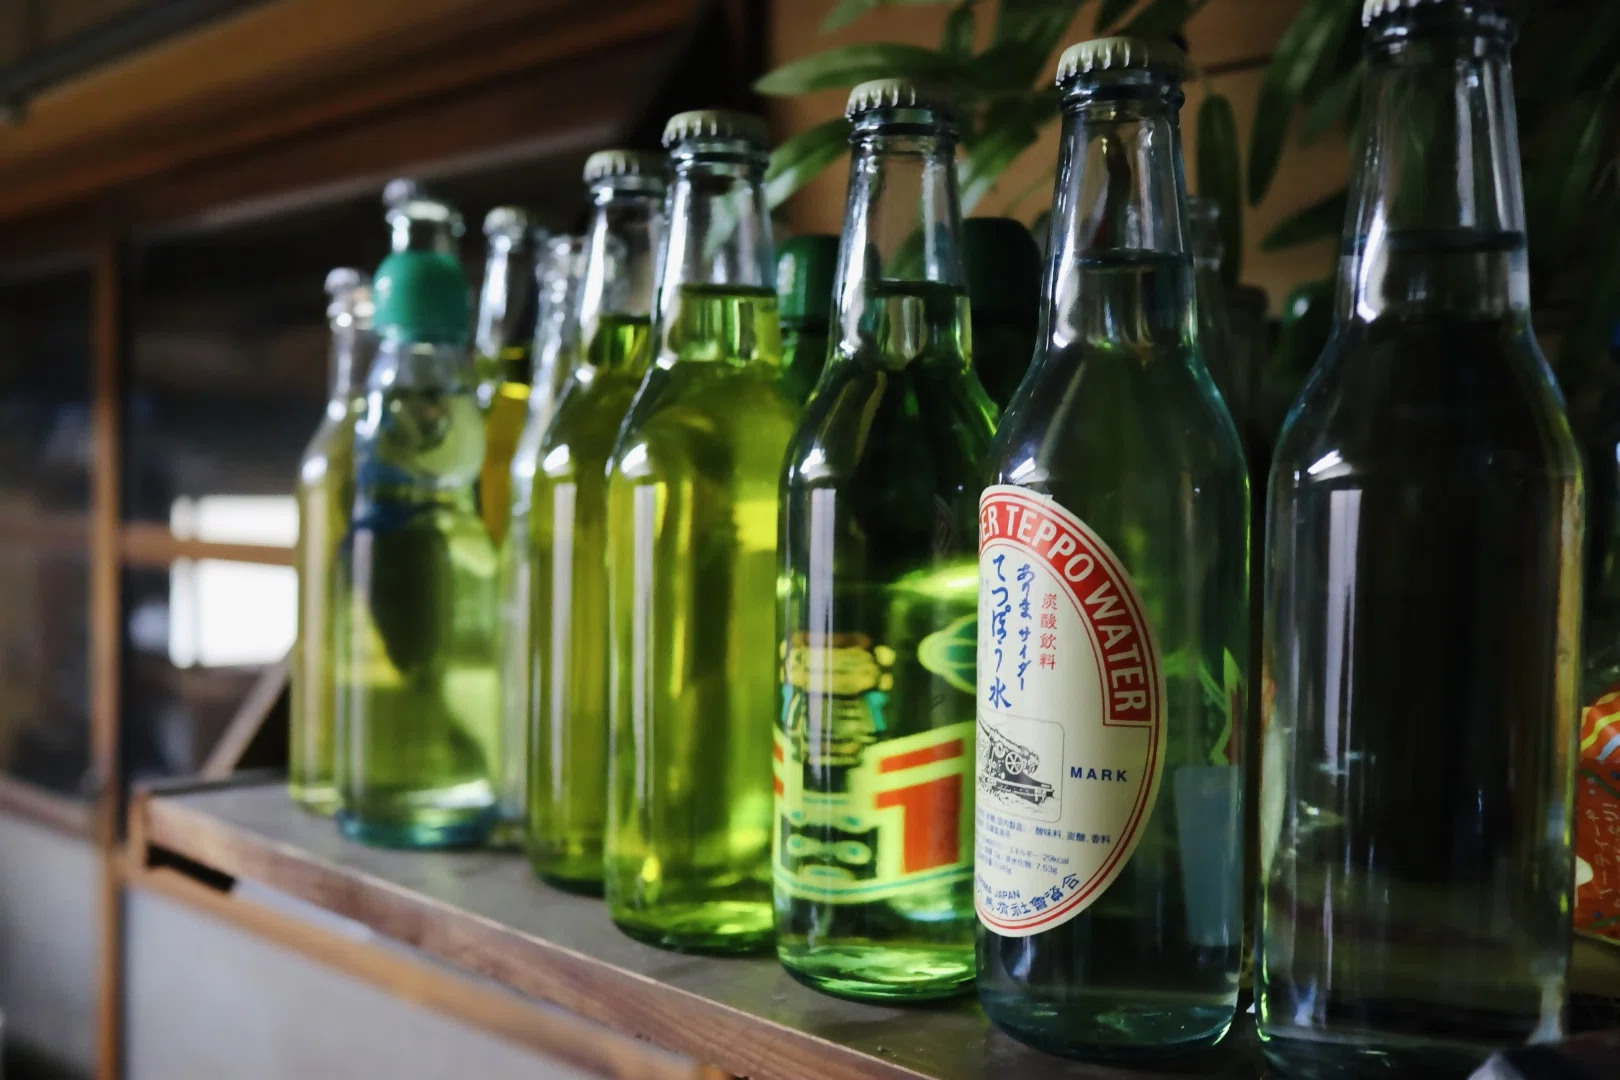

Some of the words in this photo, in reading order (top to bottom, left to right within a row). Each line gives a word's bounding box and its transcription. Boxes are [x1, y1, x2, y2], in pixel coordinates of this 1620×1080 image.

[1006, 505, 1094, 582] TEPPO
[1084, 580, 1146, 712] WATER
[1040, 593, 1058, 670] 炭酸飲料
[1017, 627, 1033, 691] サイダー
[1070, 766, 1128, 782] MARK
[994, 889, 1021, 899] JAPAN
